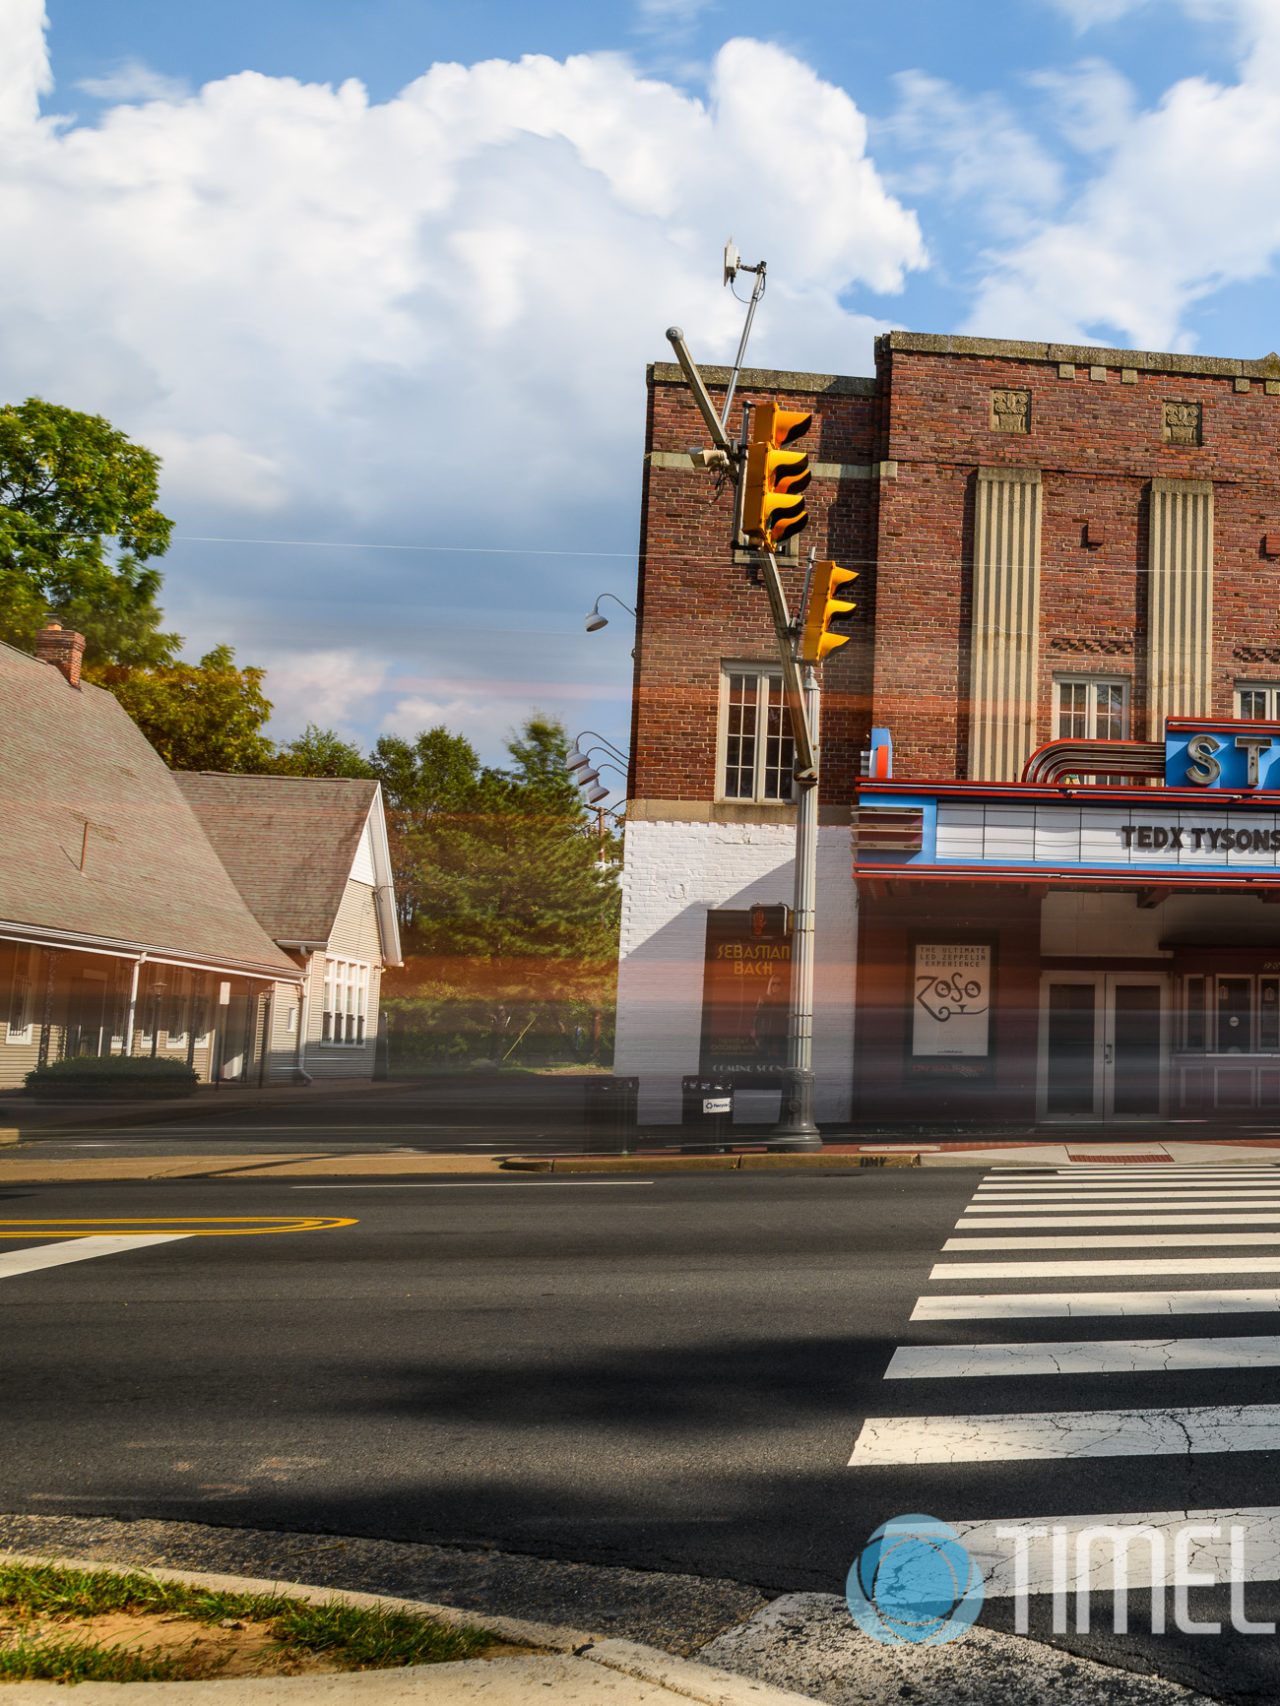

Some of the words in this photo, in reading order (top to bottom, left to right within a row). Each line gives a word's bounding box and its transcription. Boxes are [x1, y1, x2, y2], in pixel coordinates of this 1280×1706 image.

[1121, 825, 1185, 849] TEDX
[717, 944, 790, 960] SEBASTIAN
[734, 961, 773, 975] BACH
[712, 1064, 753, 1073] COMING
